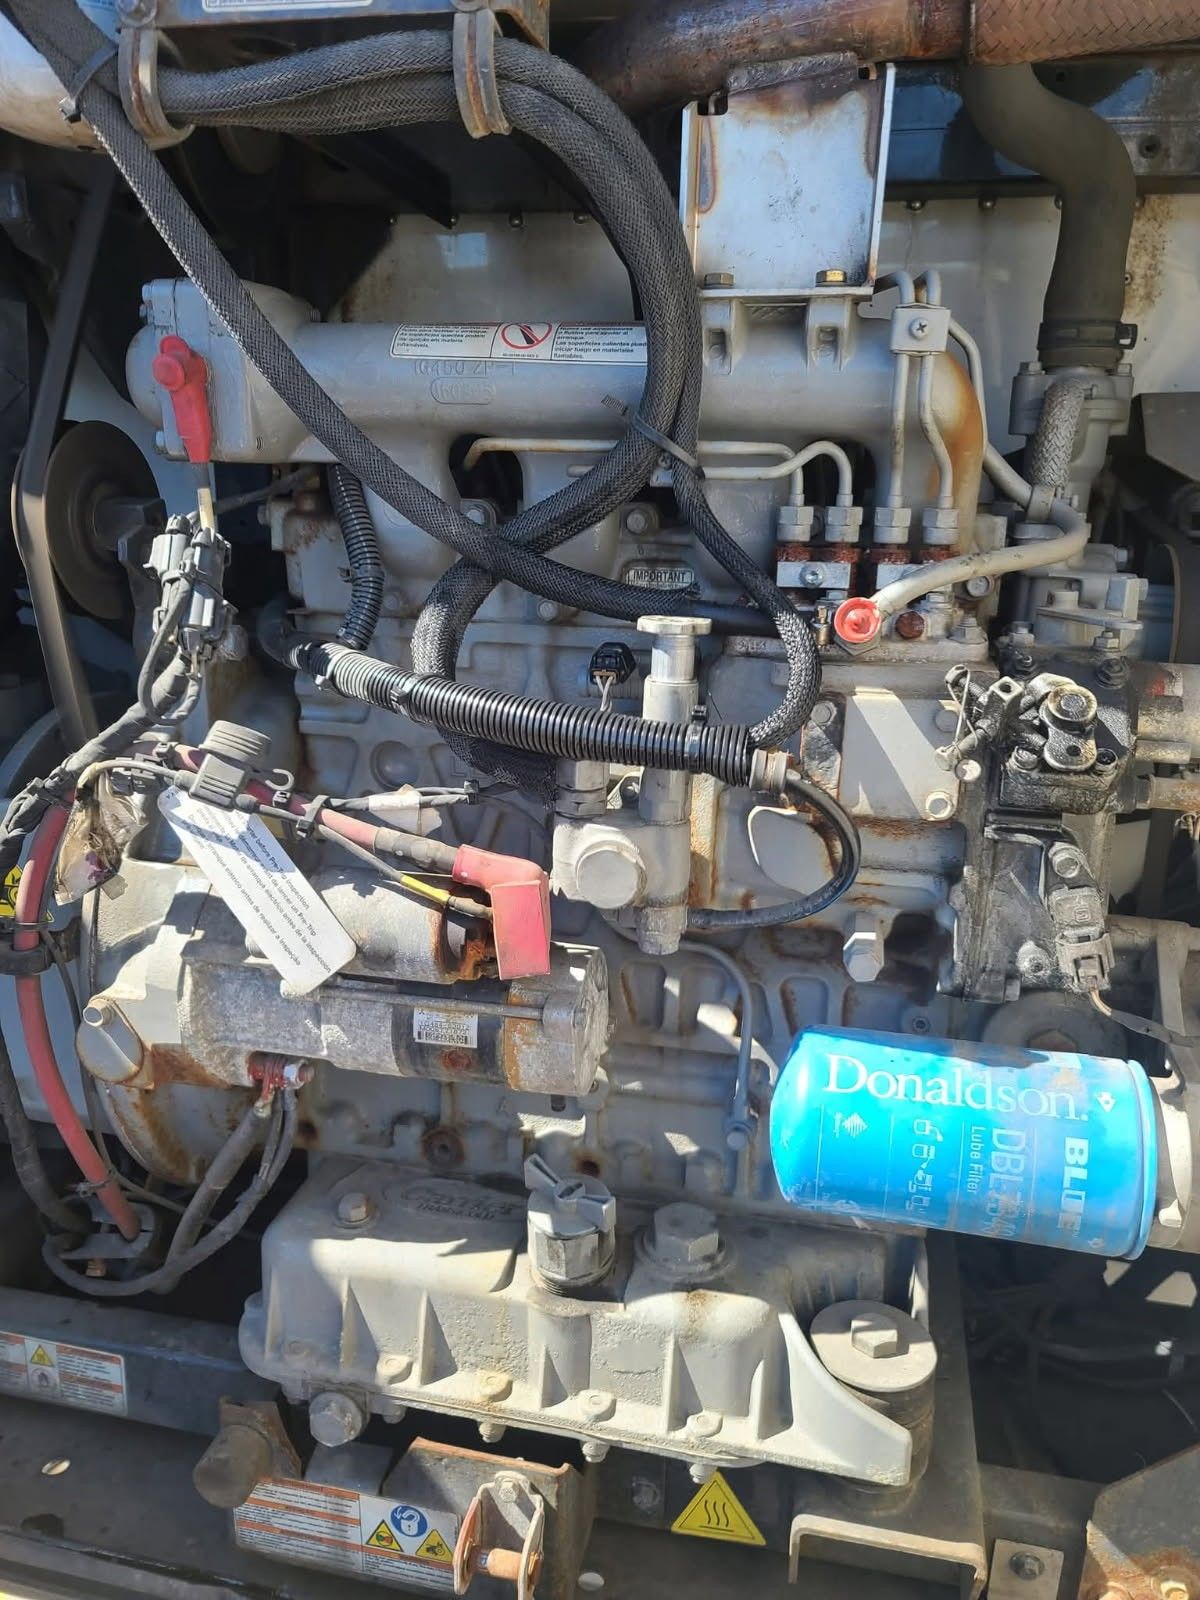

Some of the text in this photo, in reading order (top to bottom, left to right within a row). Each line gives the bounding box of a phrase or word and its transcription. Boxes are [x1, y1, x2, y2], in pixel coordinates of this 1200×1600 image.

[633, 569, 686, 583] IMPORTANT
[966, 1125, 985, 1194] Lube Filter
